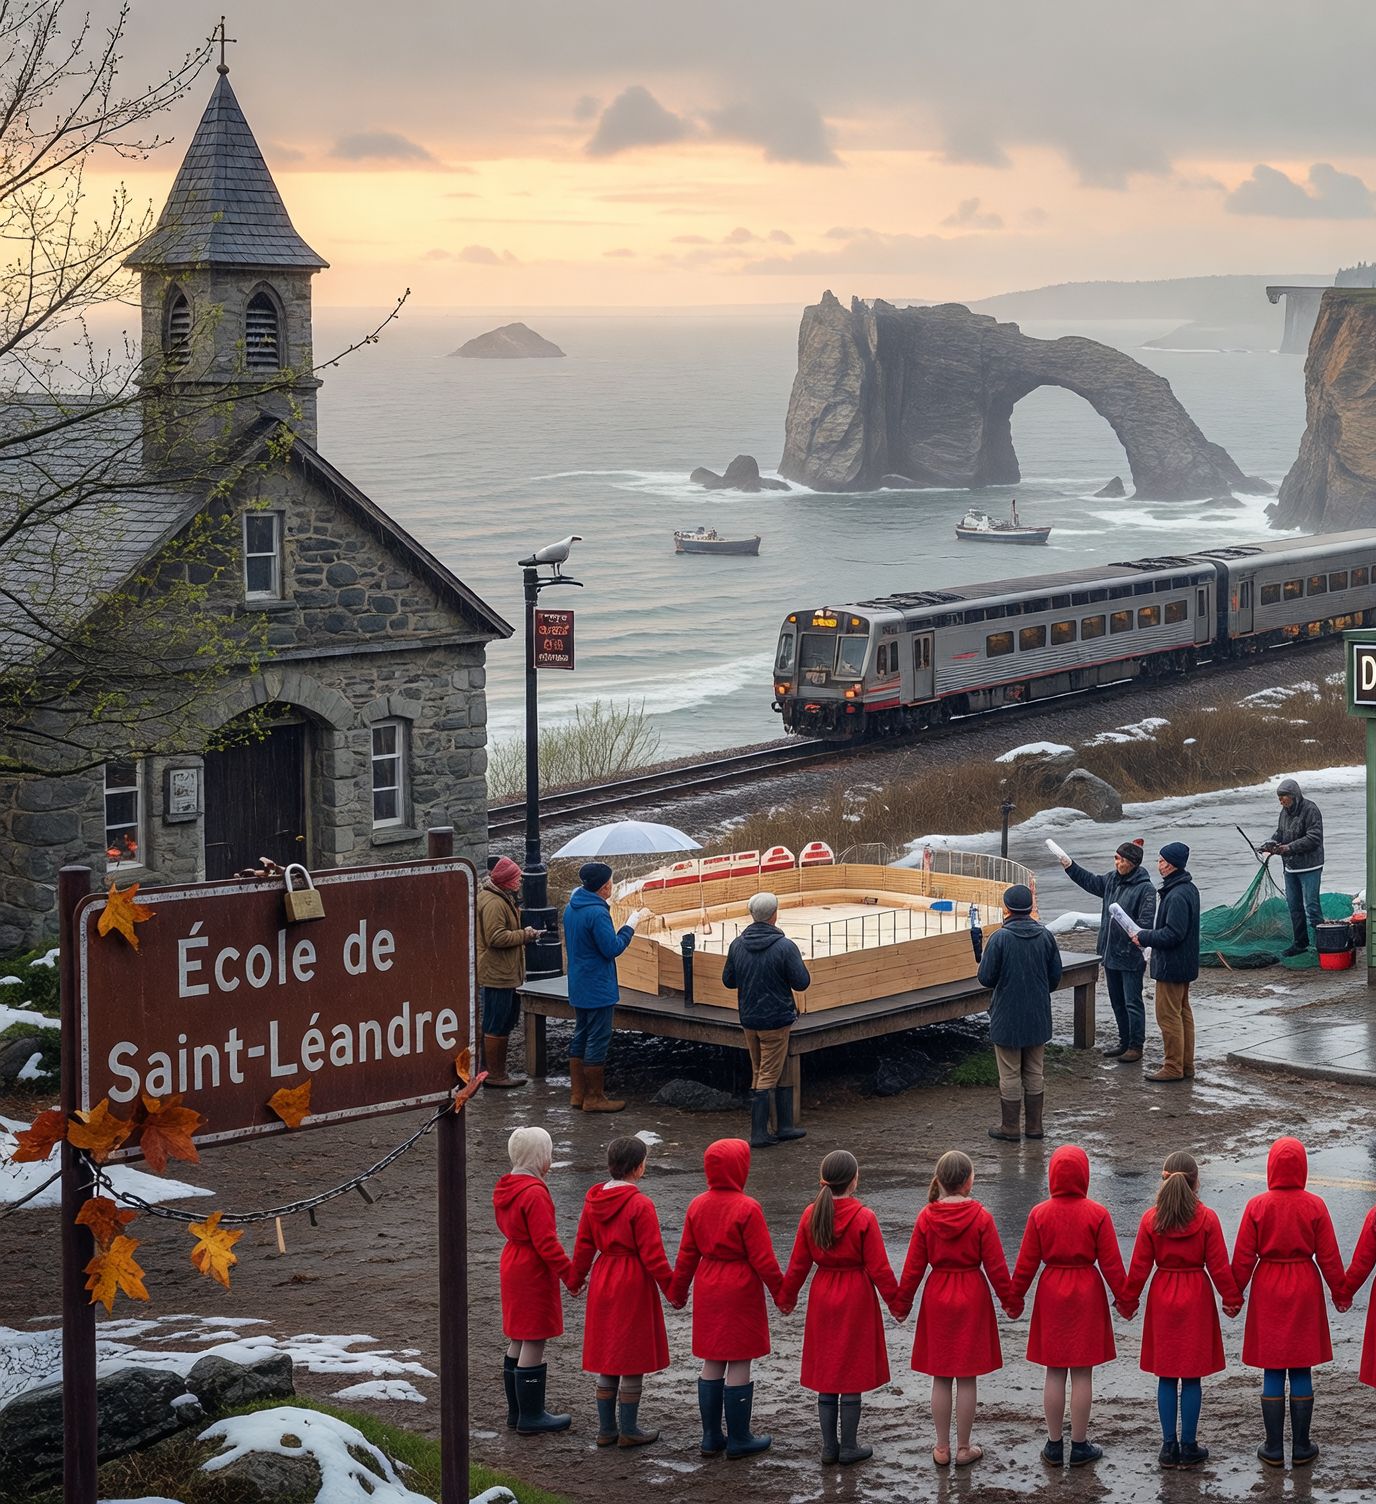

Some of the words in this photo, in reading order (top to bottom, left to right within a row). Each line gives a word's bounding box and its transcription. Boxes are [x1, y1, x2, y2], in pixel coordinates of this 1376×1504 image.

[177, 920, 317, 998] École
[343, 919, 395, 976] de
[108, 1001, 459, 1103] Saint-Léandre
